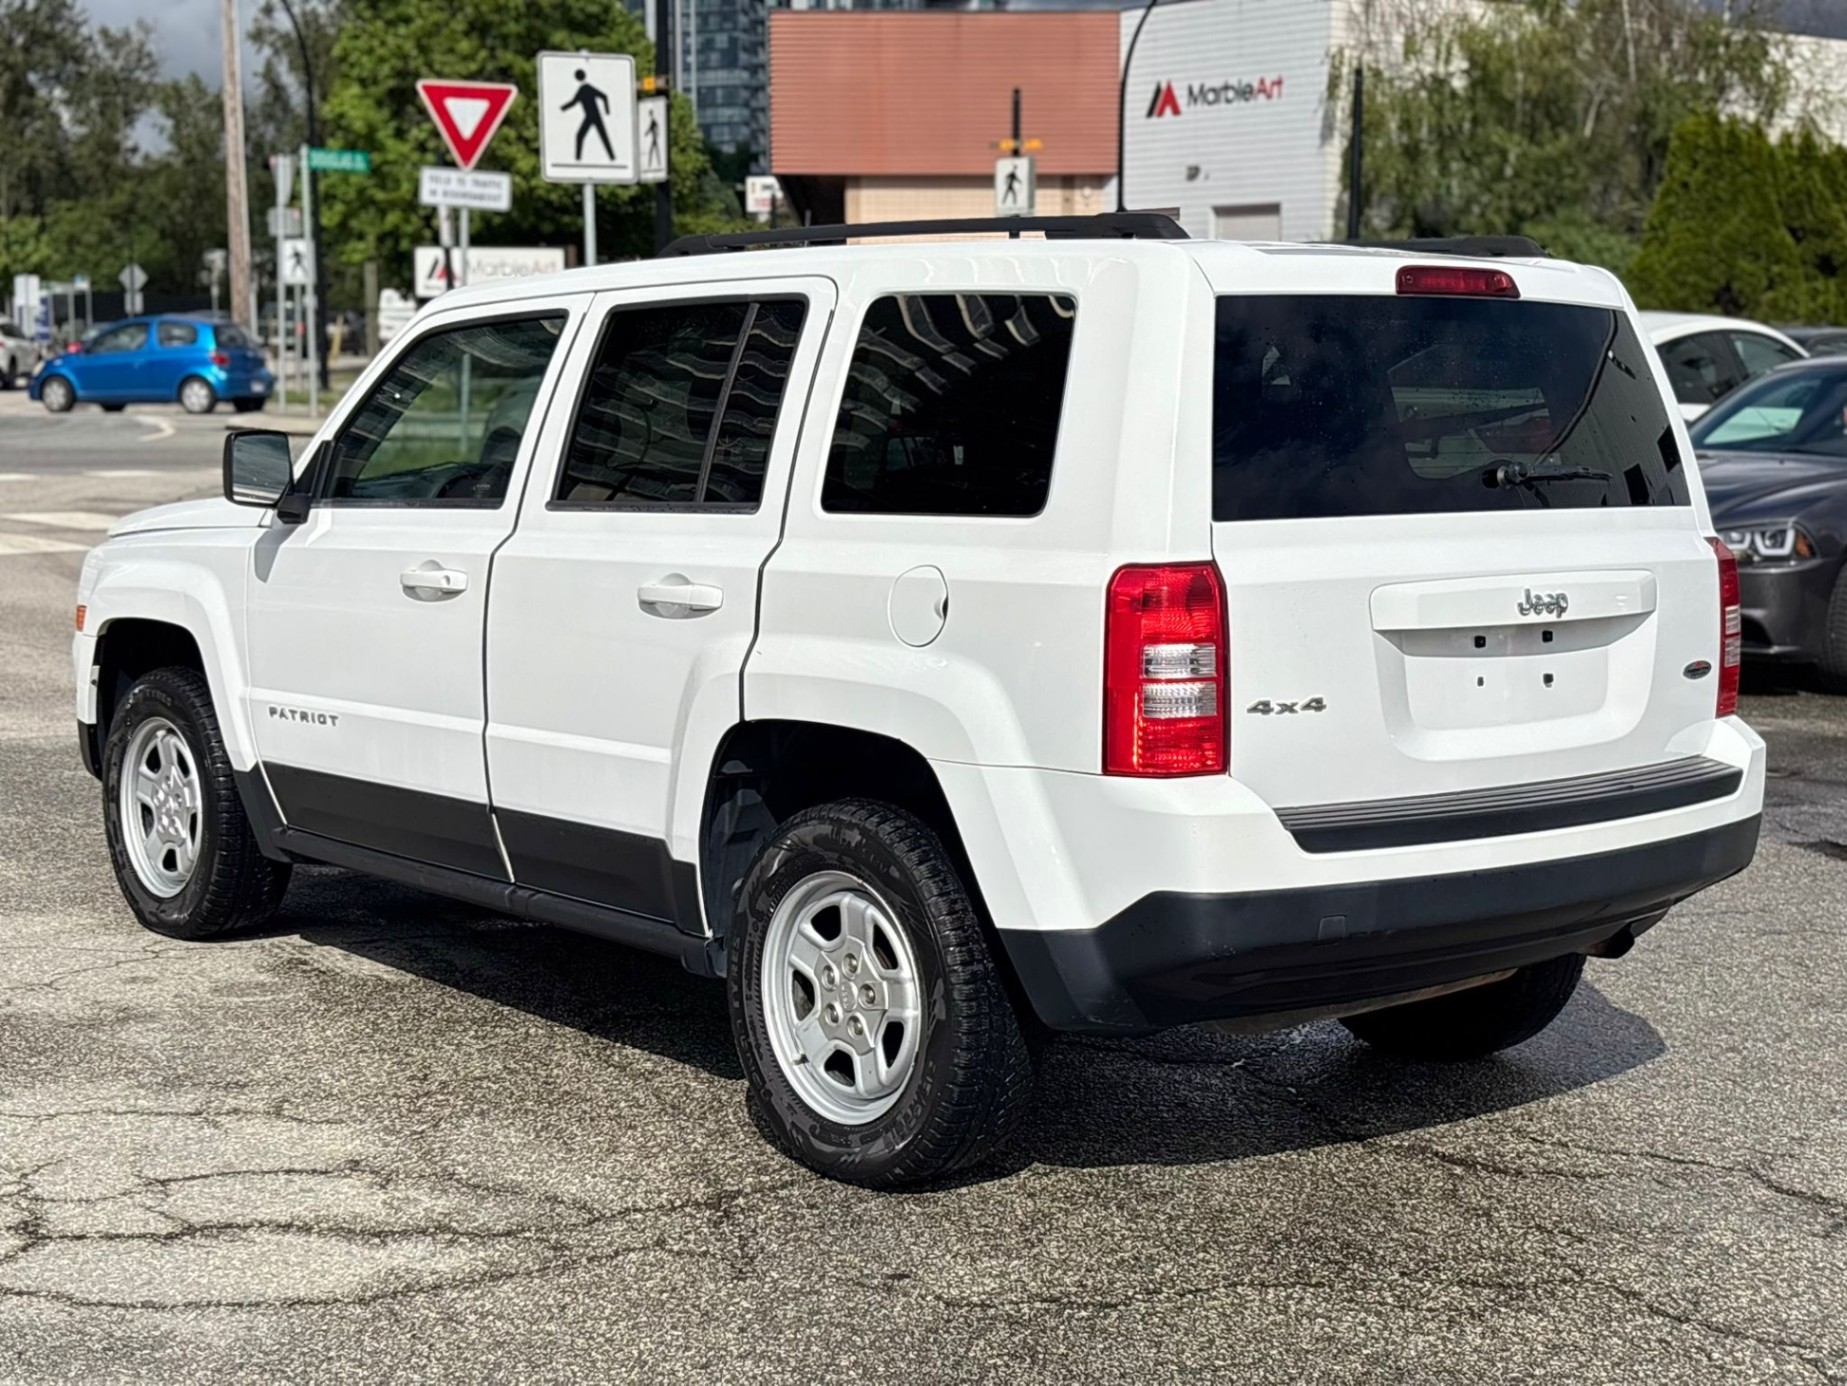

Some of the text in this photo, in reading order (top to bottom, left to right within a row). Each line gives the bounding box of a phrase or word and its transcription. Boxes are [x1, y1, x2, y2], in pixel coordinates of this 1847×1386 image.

[1187, 75, 1283, 106] MarbleArt
[1517, 588, 1568, 619] Jeep
[269, 706, 339, 727] PATRIOT
[1246, 697, 1327, 715] 4x4
